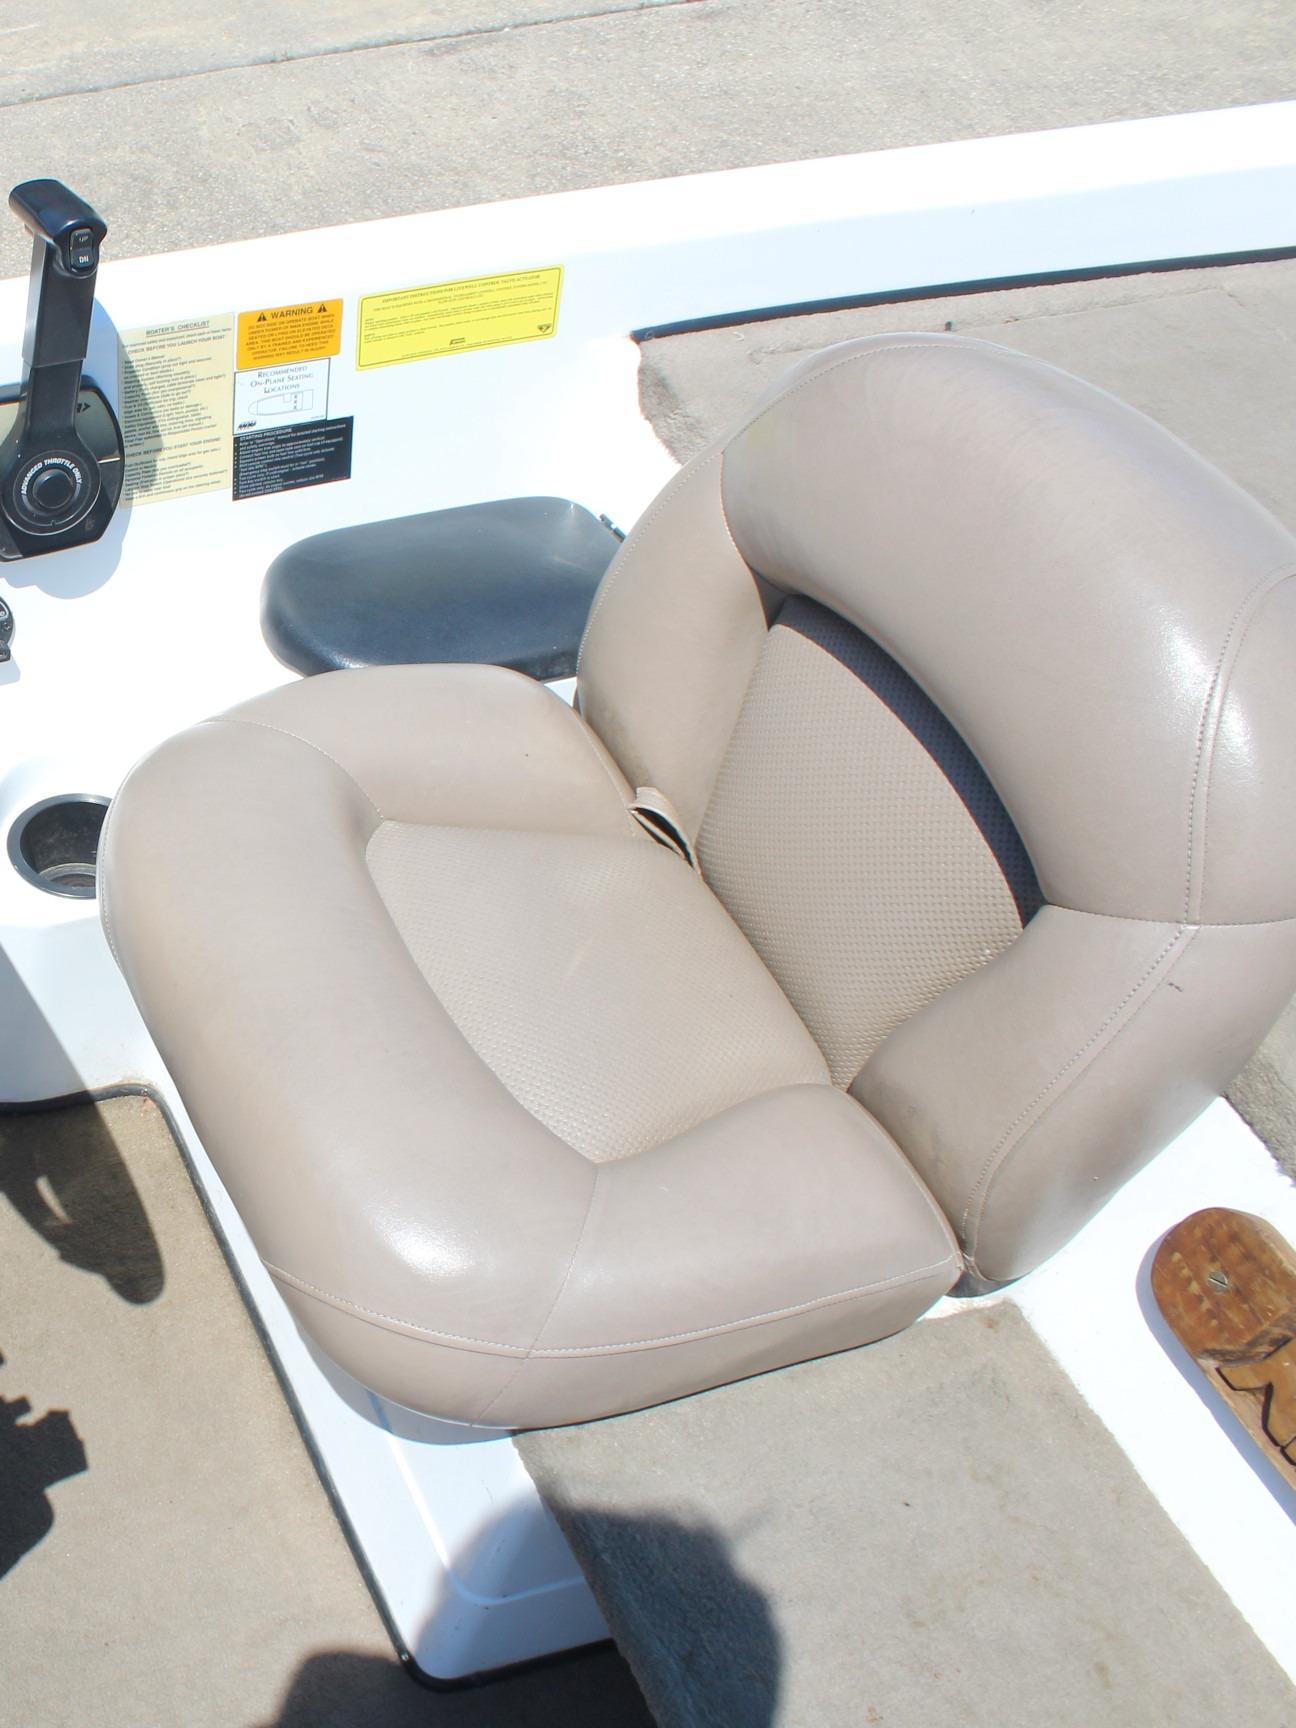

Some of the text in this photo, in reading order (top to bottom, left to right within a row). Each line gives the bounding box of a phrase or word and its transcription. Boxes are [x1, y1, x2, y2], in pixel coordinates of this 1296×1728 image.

[78, 255, 89, 264] DN
[271, 306, 313, 319] WARNING
[21, 457, 83, 495] ADVANCED THROTTLE ONLY
